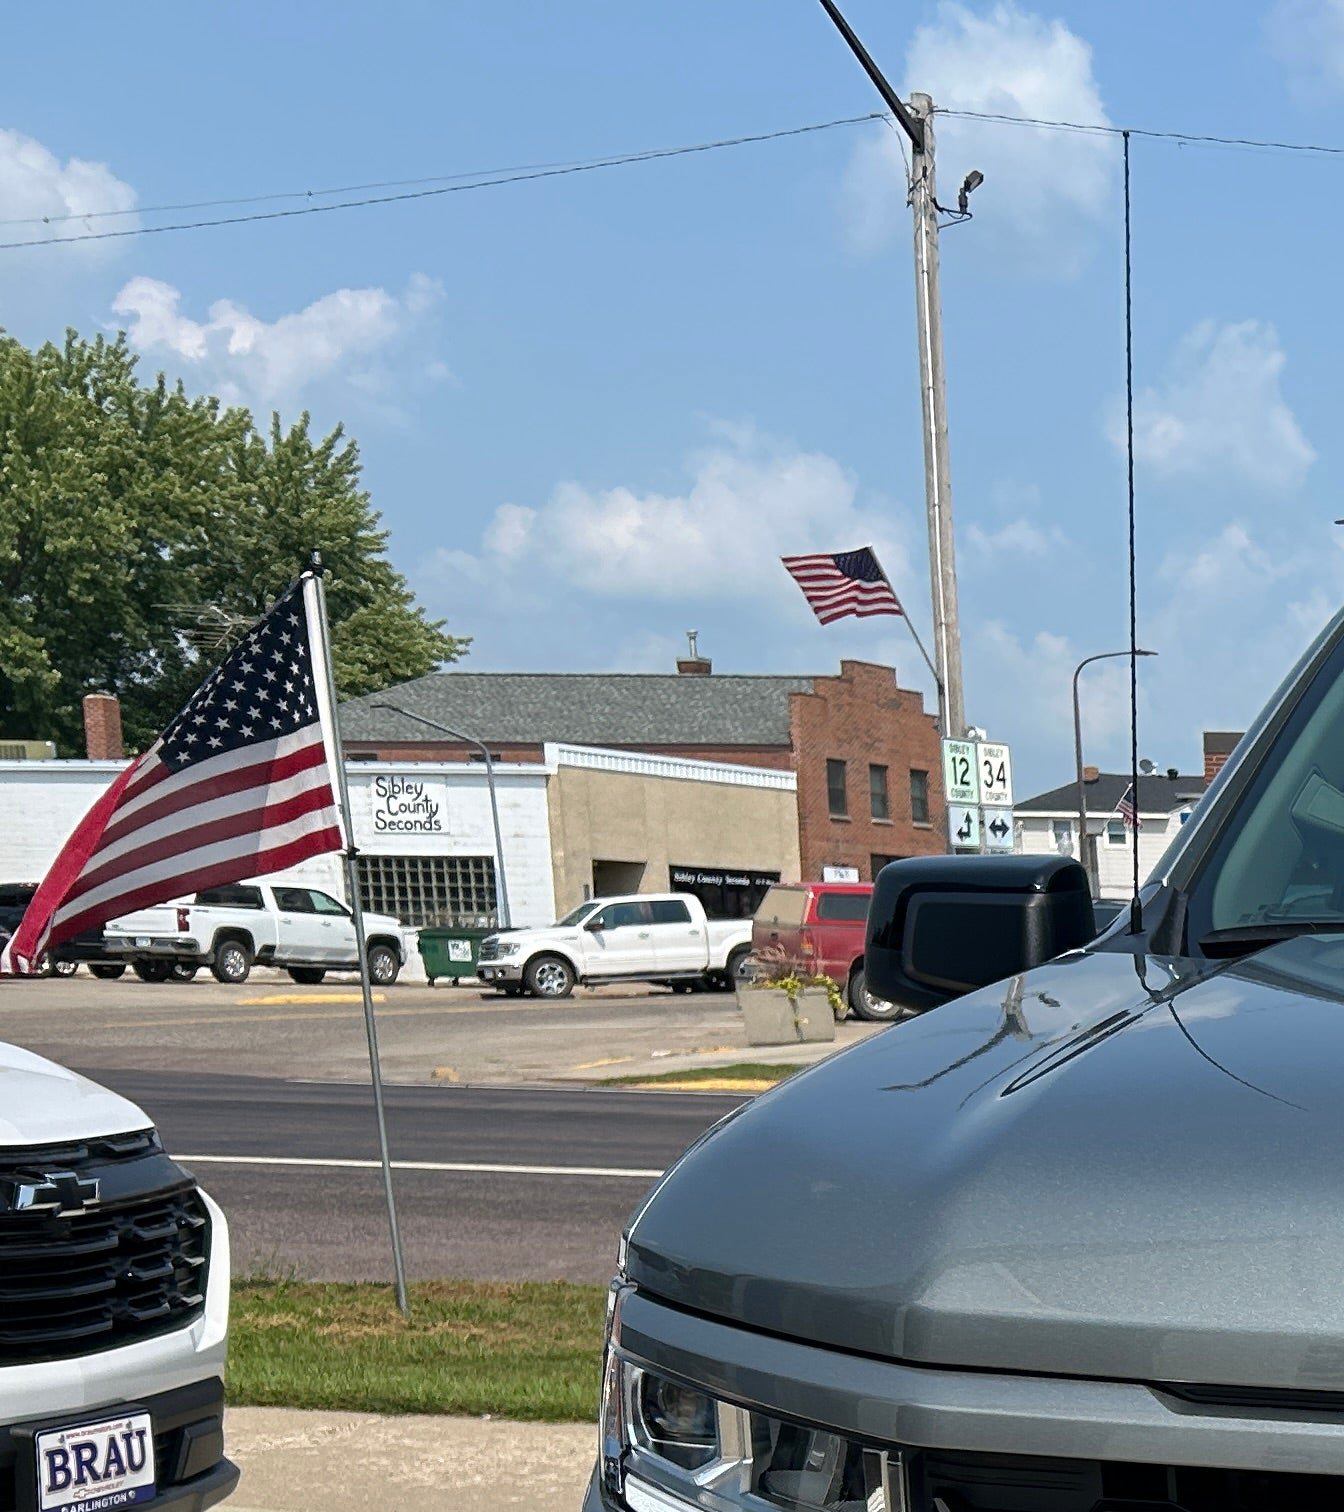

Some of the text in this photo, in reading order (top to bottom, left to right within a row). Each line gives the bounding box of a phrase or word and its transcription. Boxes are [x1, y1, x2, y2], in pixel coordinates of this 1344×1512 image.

[951, 756, 970, 786] 12
[983, 760, 1007, 789] 34
[375, 775, 424, 801] Sibley
[374, 809, 442, 832] Seconds
[386, 794, 439, 820] County
[43, 1427, 147, 1495] BRAU
